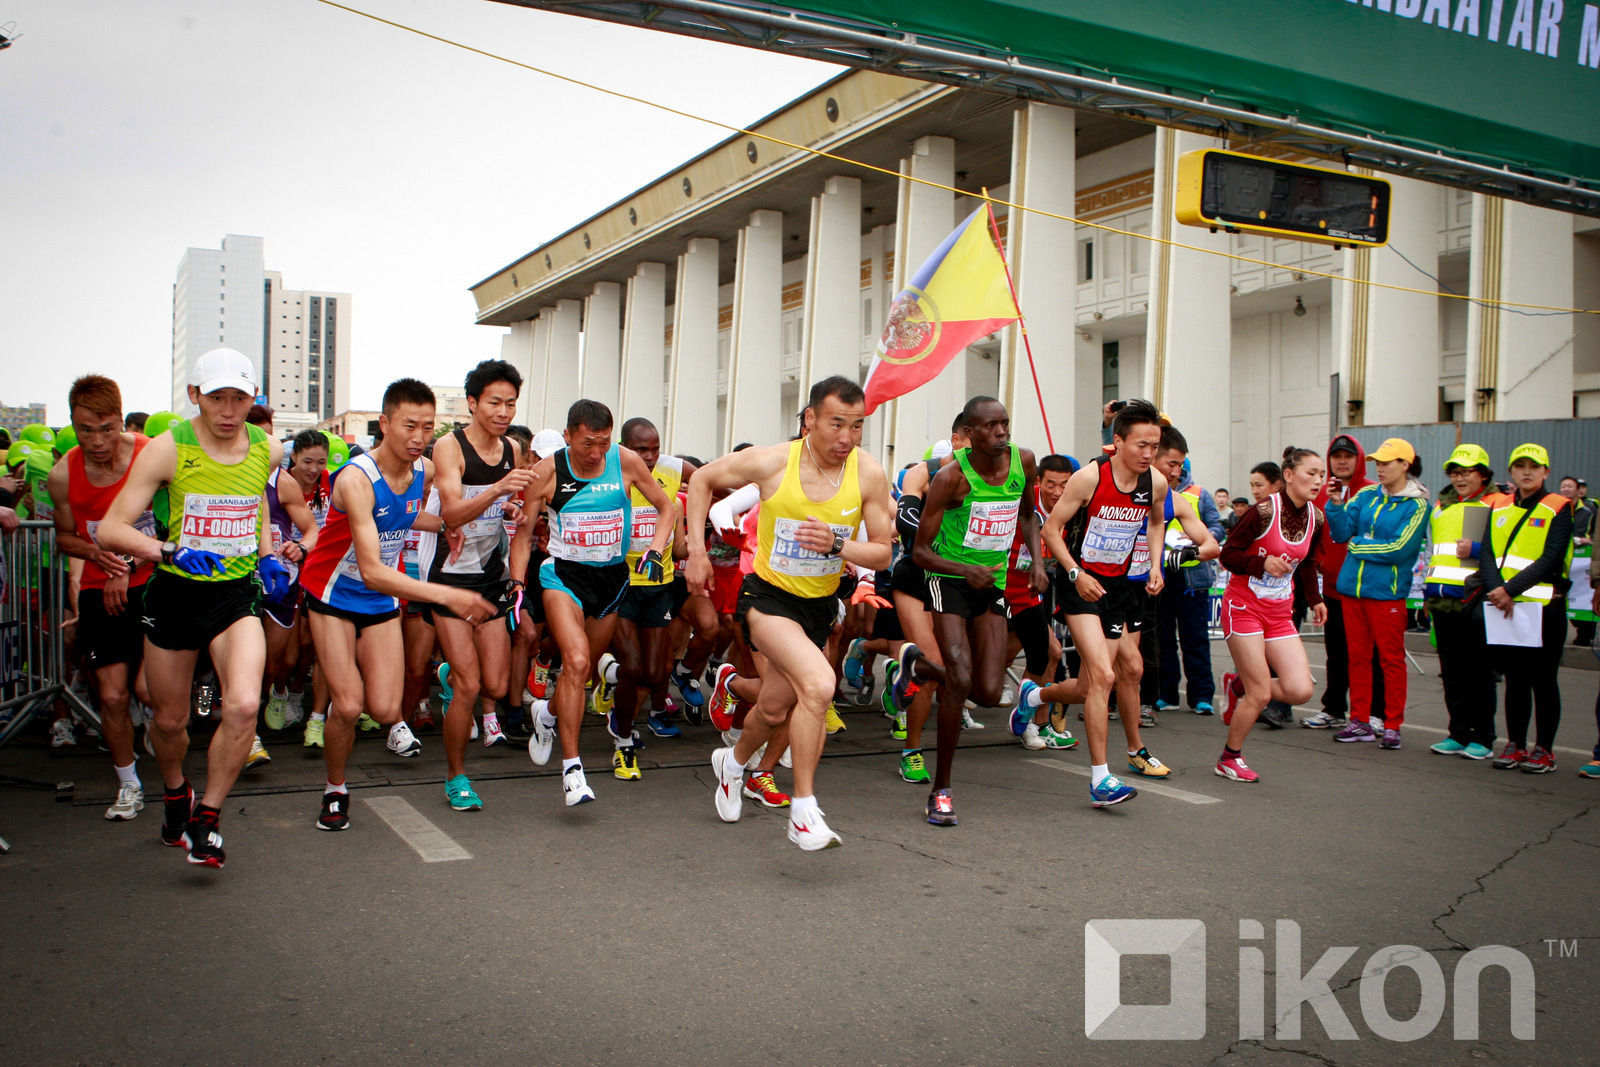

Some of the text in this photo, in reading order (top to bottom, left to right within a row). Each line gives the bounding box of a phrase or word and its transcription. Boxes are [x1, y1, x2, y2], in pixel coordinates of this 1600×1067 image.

[591, 483, 620, 492] NTN
[1097, 505, 1147, 521] MONGOLIA
[185, 516, 257, 536] A1-00099
[565, 529, 621, 546] A1-00001
